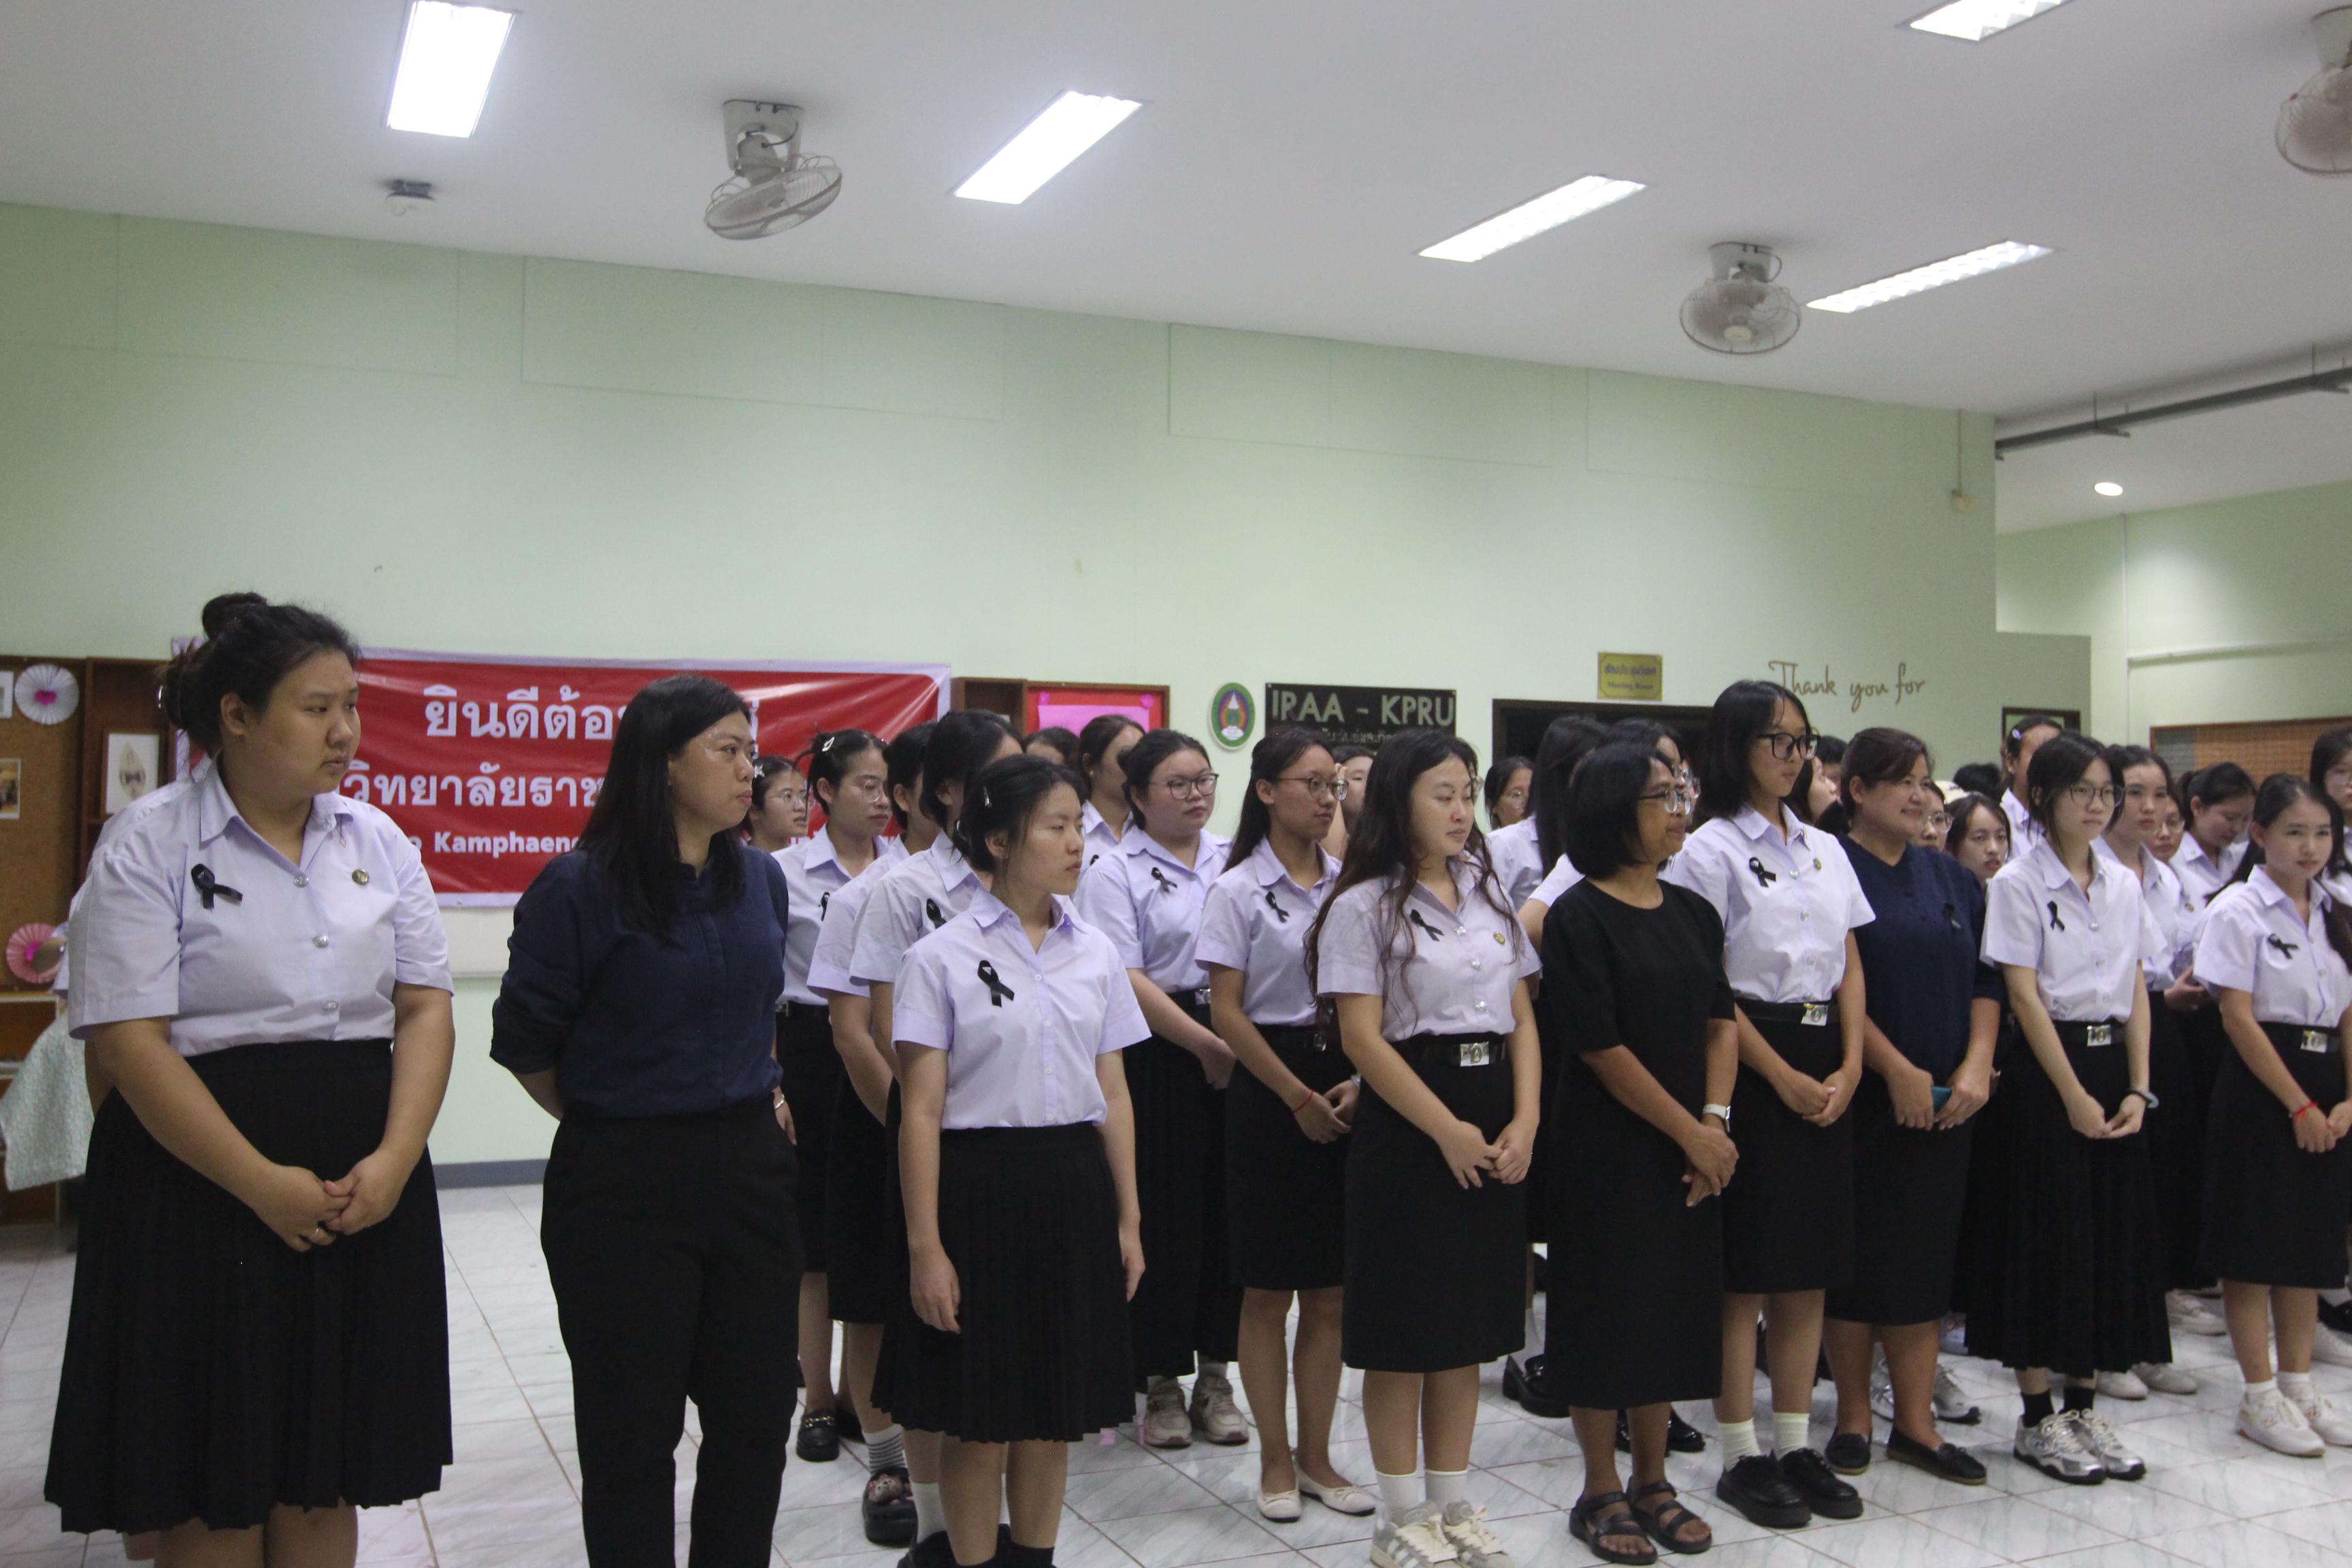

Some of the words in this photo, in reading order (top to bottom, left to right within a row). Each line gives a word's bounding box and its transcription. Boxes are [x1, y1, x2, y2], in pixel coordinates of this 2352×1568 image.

[1768, 661, 1837, 696] Thank
[1849, 680, 1889, 713] you
[1895, 662, 1926, 705] for
[1381, 694, 1454, 727] KPRU
